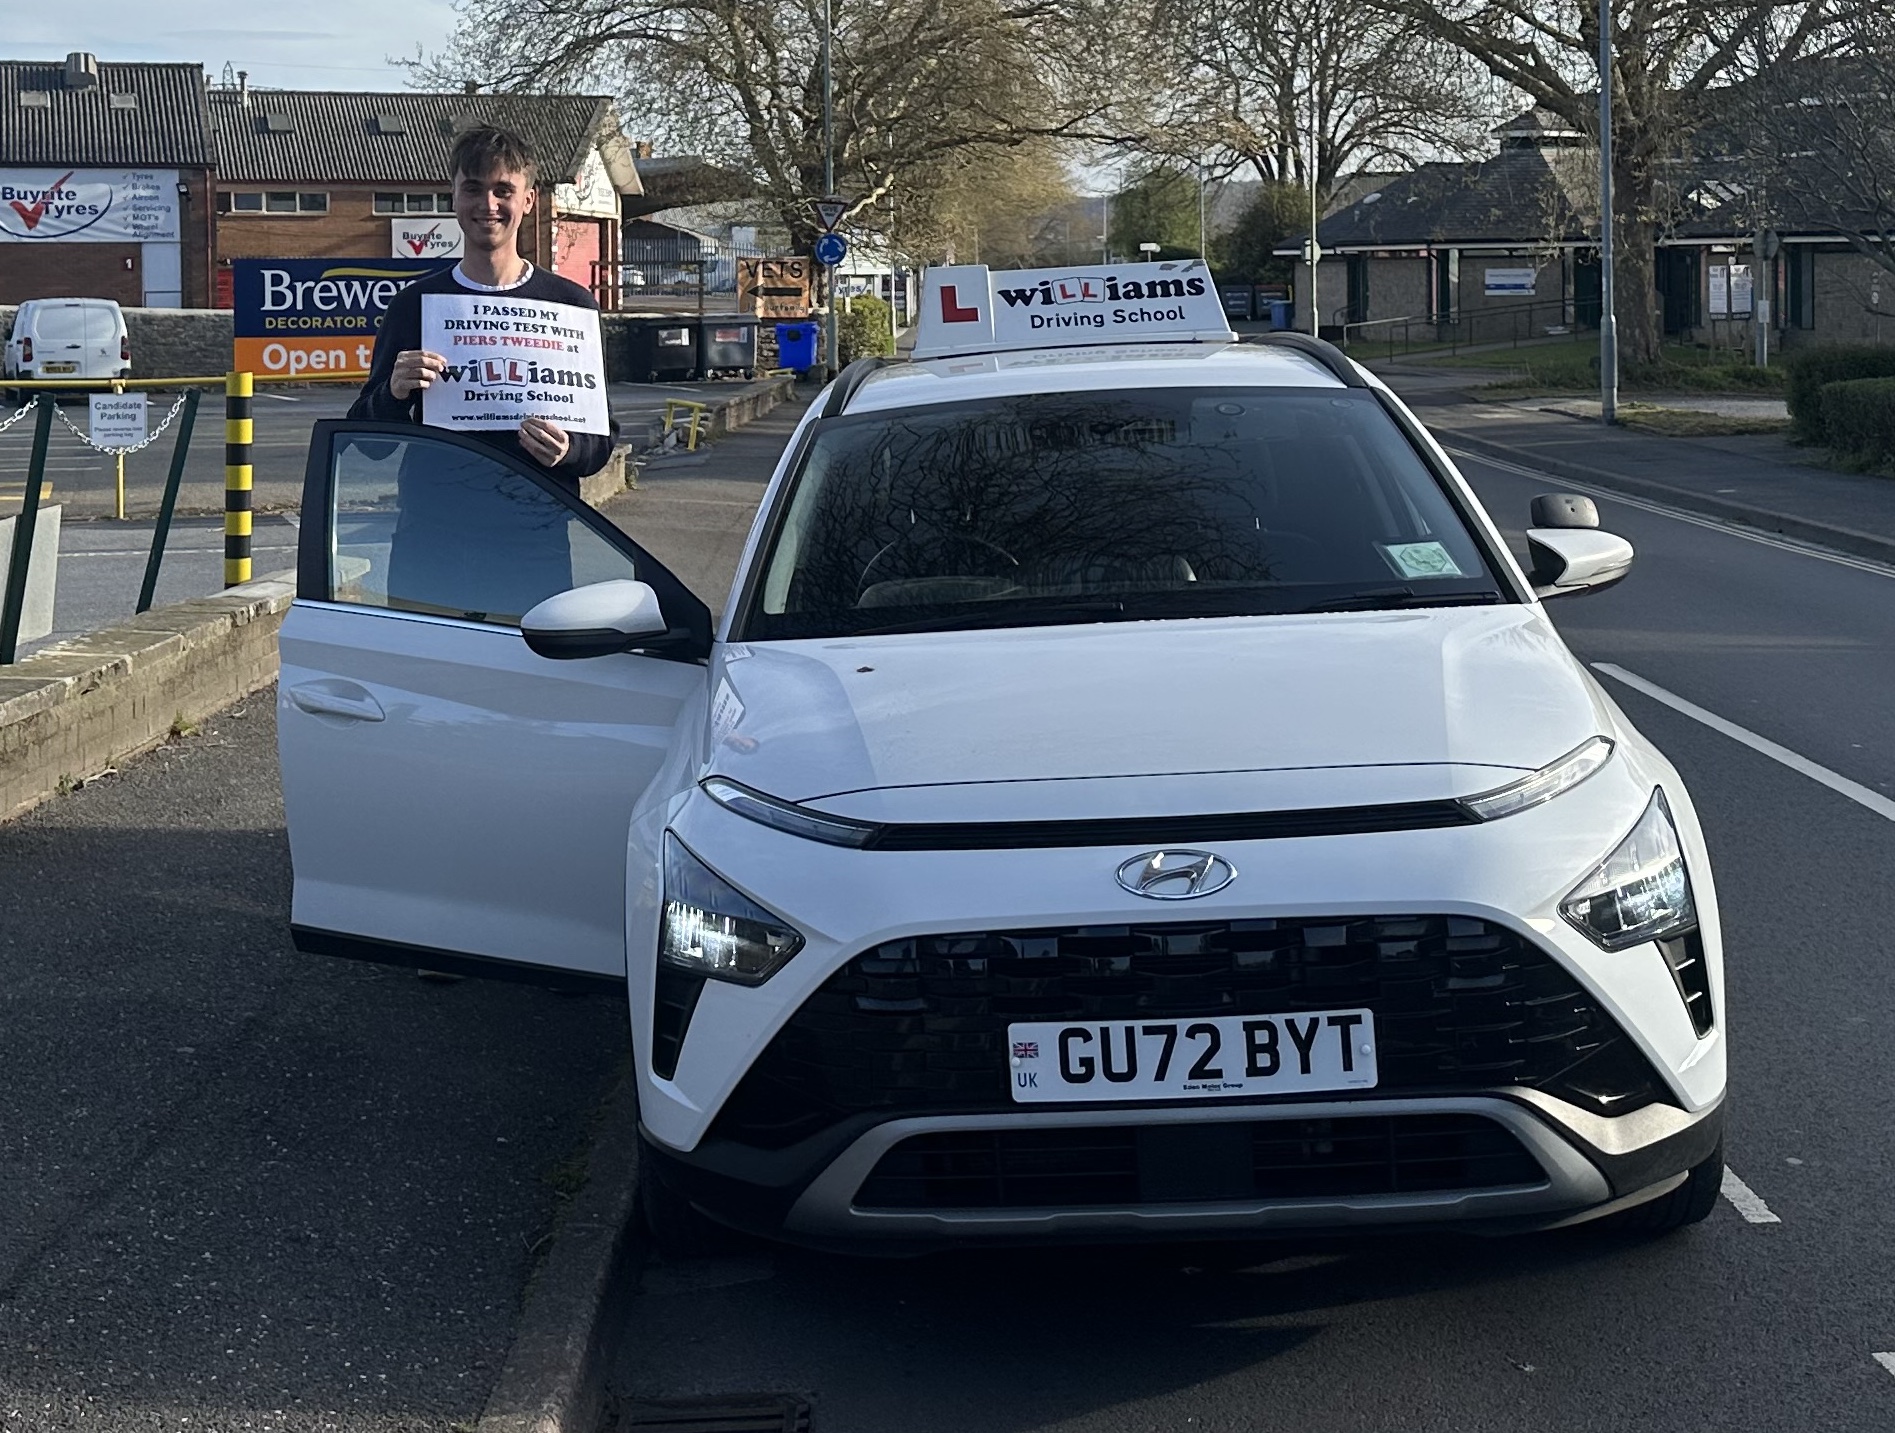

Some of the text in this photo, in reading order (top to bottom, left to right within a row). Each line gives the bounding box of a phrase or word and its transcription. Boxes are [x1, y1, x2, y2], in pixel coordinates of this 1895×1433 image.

[2, 186, 77, 204] Buyrite
[41, 201, 99, 218] Tyres
[423, 239, 454, 250] Tyres
[746, 260, 803, 279] VETS
[940, 285, 980, 324] L
[473, 305, 559, 322] I PASSED MY
[1031, 305, 1185, 329] Driving School
[265, 316, 367, 330] DECORATOR
[444, 319, 585, 340] DRIVING TEST WITH
[453, 335, 579, 353] PIERS TWEEDIE at
[262, 343, 346, 376] Open
[94, 401, 142, 410] Candidate
[464, 390, 575, 404] Driving School
[100, 411, 137, 421] Parking
[1058, 1013, 1363, 1084] GU72 BYT
[1017, 1072, 1038, 1089] UK
